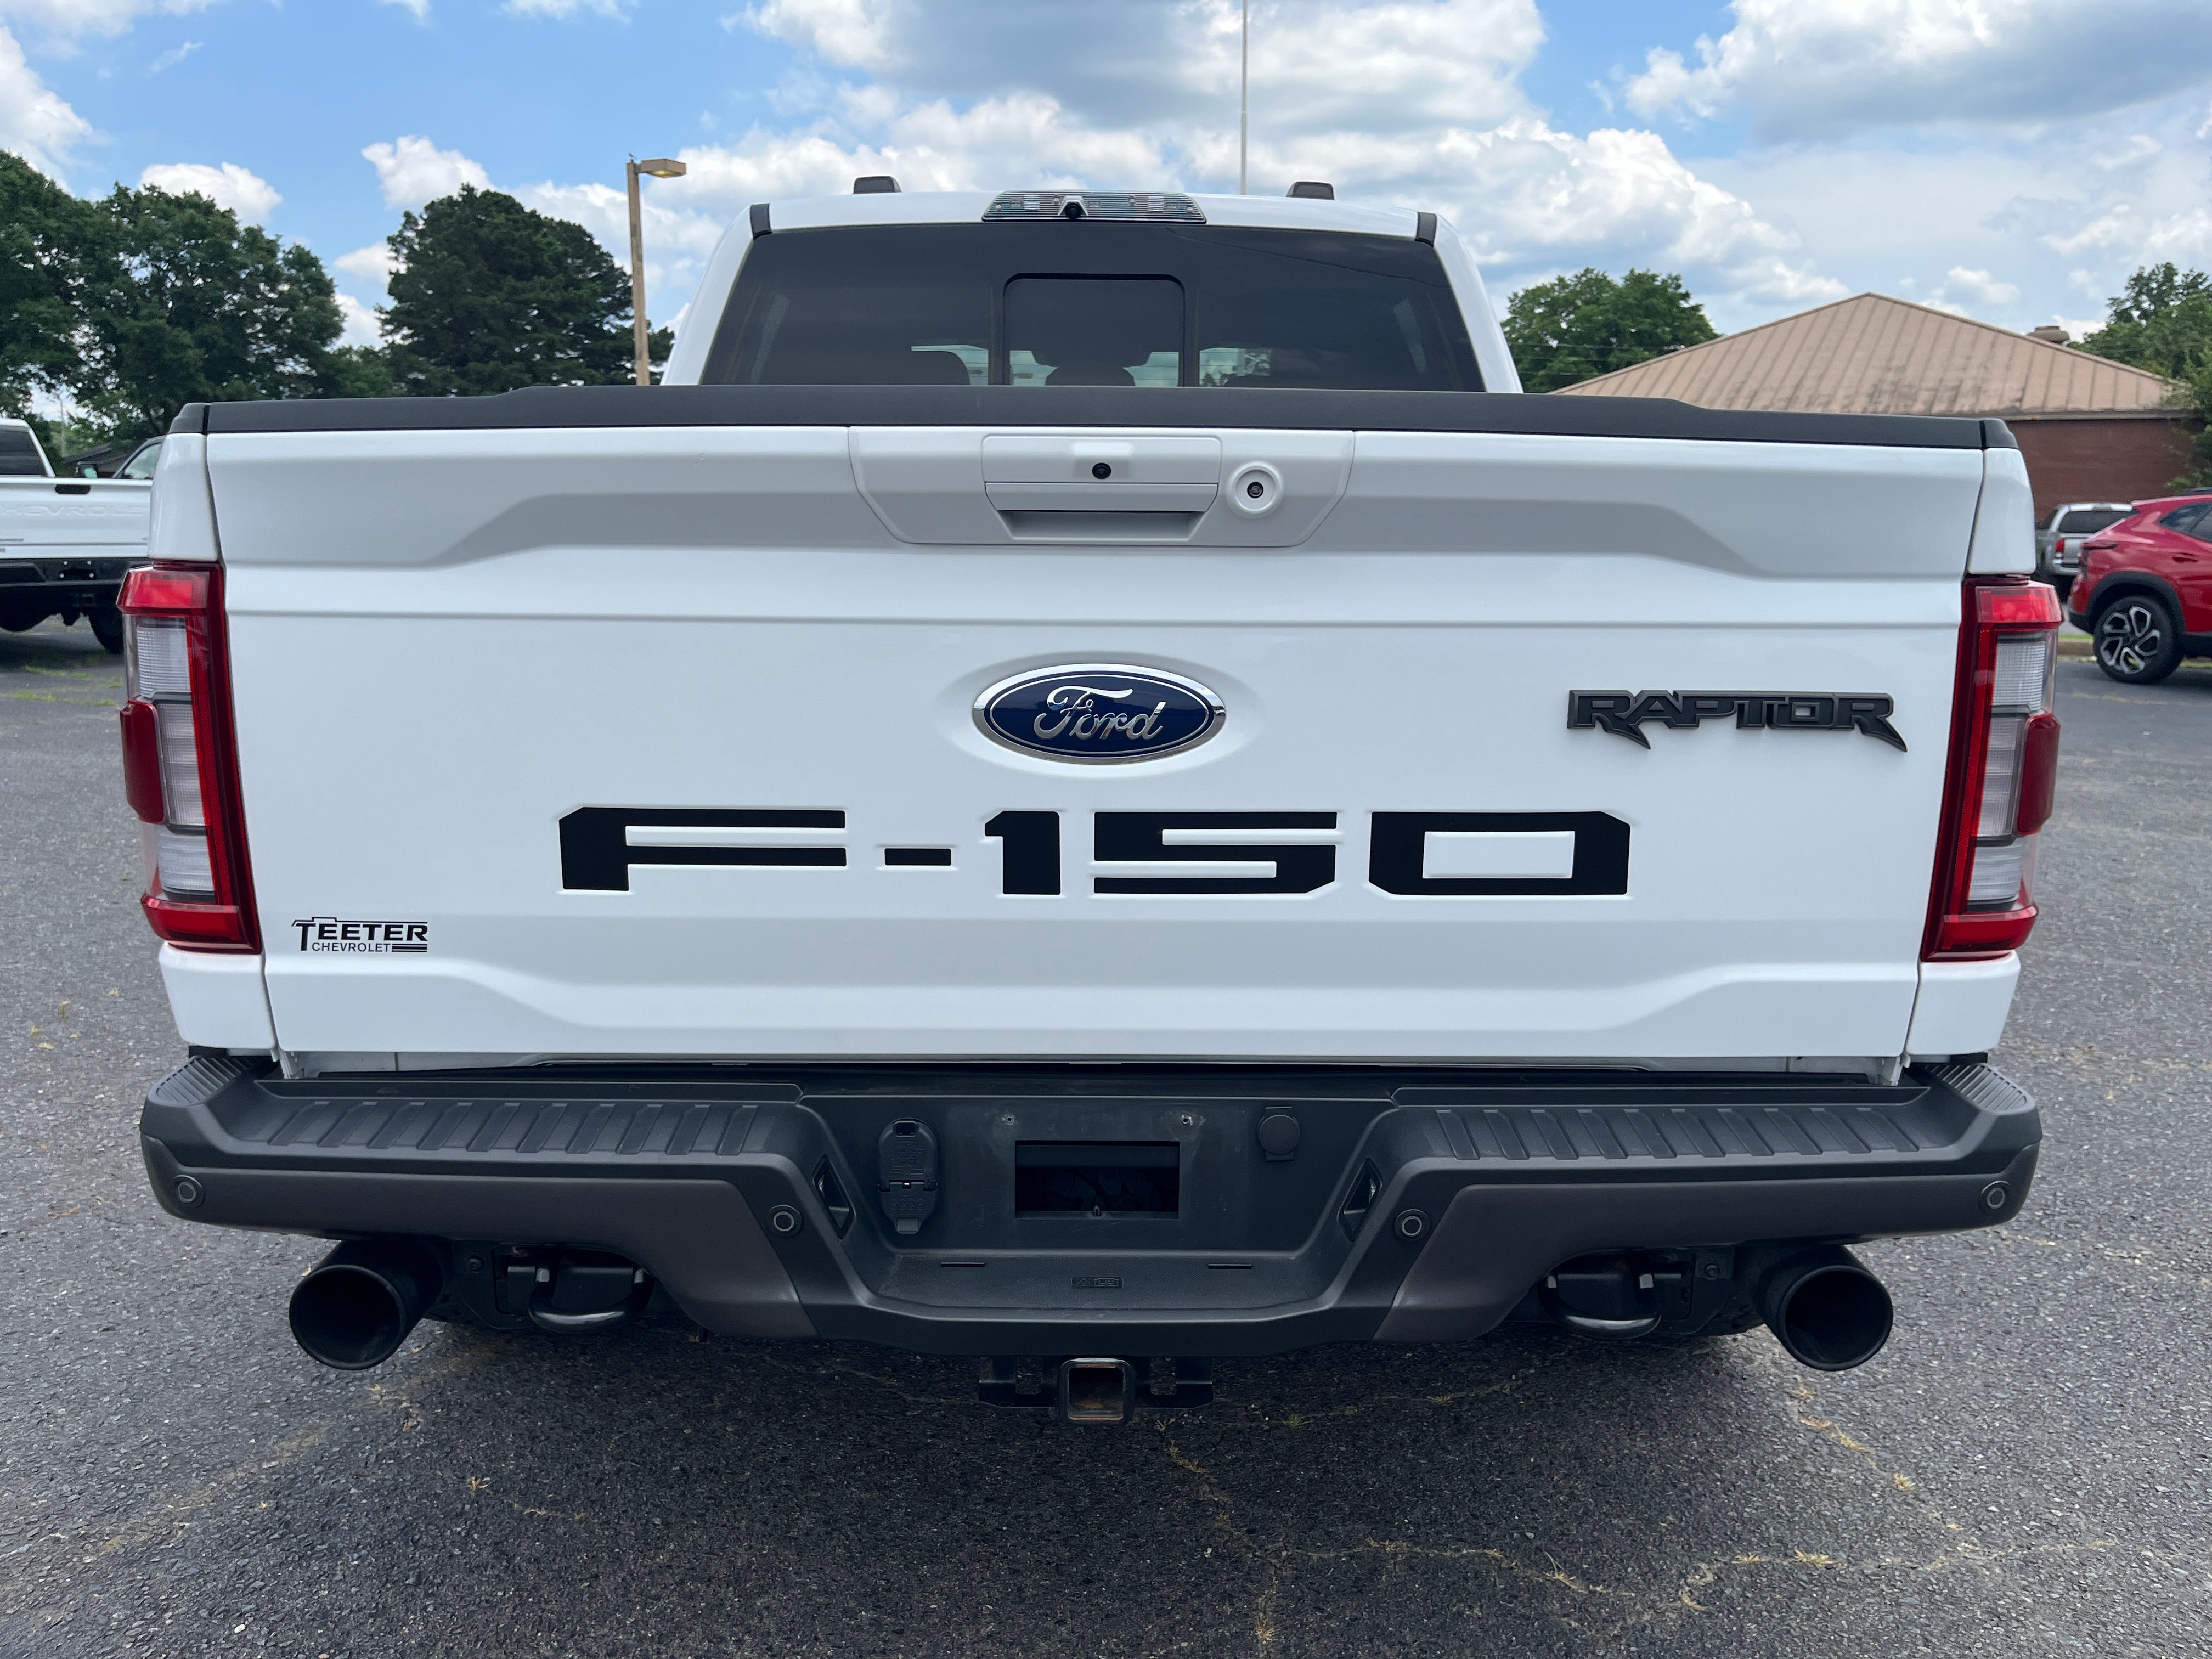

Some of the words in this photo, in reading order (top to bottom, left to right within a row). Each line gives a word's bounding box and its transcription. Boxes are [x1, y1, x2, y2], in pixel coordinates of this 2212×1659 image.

[1033, 685, 1167, 741] Ford
[1567, 690, 1908, 752] RAPTOR
[559, 806, 1630, 895] F-150
[295, 923, 428, 951] TEETER
[312, 942, 391, 952] CHEVROLET
